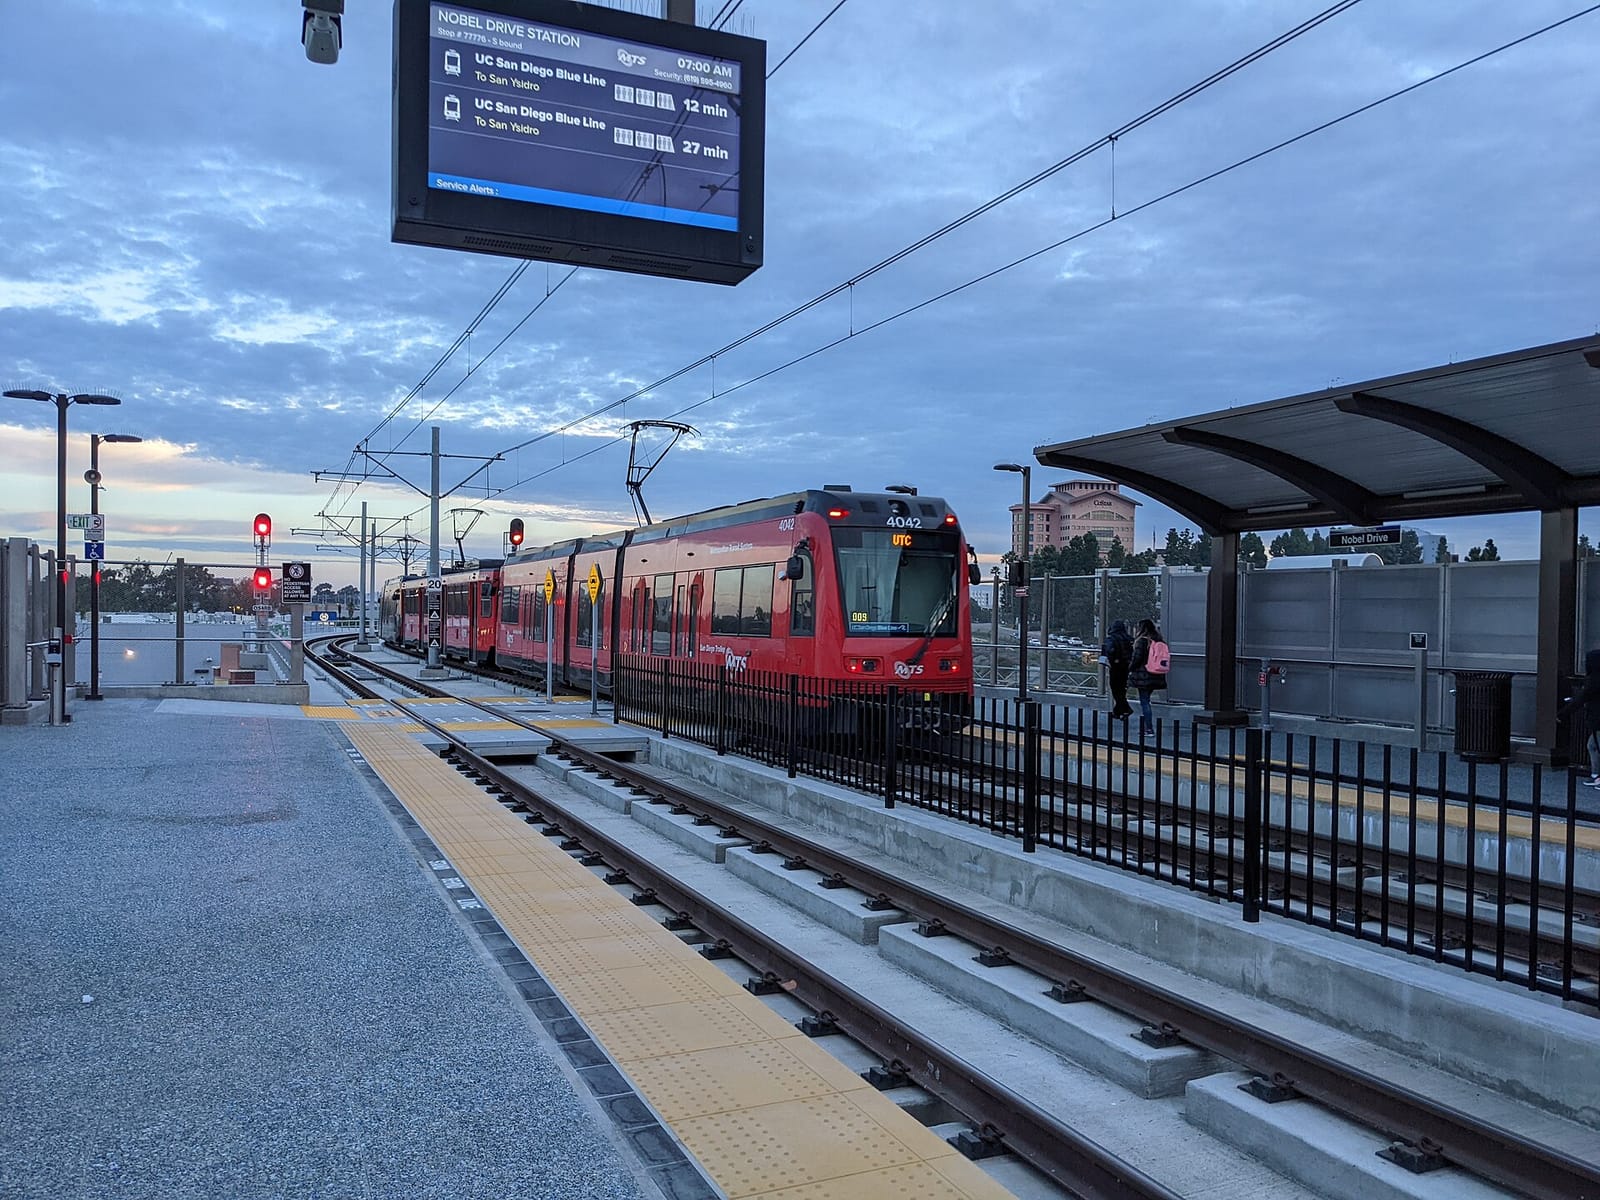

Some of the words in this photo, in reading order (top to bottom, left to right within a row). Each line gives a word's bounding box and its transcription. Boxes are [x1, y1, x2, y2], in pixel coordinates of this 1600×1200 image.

[438, 9, 483, 30] NOBEL
[486, 18, 524, 37] DRIVE
[527, 27, 580, 48] STATION
[438, 27, 456, 38] Stop
[492, 37, 498, 46] S
[498, 38, 523, 50] bound
[475, 52, 494, 66] UC
[496, 56, 518, 71] San
[520, 61, 554, 78] Diego
[556, 68, 582, 82] Blue
[583, 73, 607, 88] Line
[654, 68, 682, 81] Security:
[678, 58, 710, 74] 07:00
[713, 64, 732, 78] AM
[474, 70, 487, 82] To
[489, 74, 508, 86] San
[510, 78, 540, 92] Ysidro
[474, 98, 494, 111] UC
[496, 102, 518, 116] San
[520, 106, 553, 122] Diego
[556, 112, 581, 126] Blue
[582, 116, 606, 130] Line
[683, 98, 700, 113] 12
[702, 104, 728, 118] min
[474, 116, 487, 127] To
[488, 119, 508, 130] San
[510, 122, 540, 136] Ysidro
[682, 140, 700, 154] 27
[703, 145, 729, 160] min
[436, 178, 468, 191] Service
[470, 184, 494, 196] Alerts
[72, 516, 90, 528] EXIT
[778, 518, 795, 532] 4042
[886, 516, 922, 529] 4042
[892, 534, 912, 546] UTC
[1341, 534, 1365, 544] Nobel
[1366, 533, 1388, 542] Drive
[428, 580, 442, 588] 20
[894, 663, 924, 678] MTS
